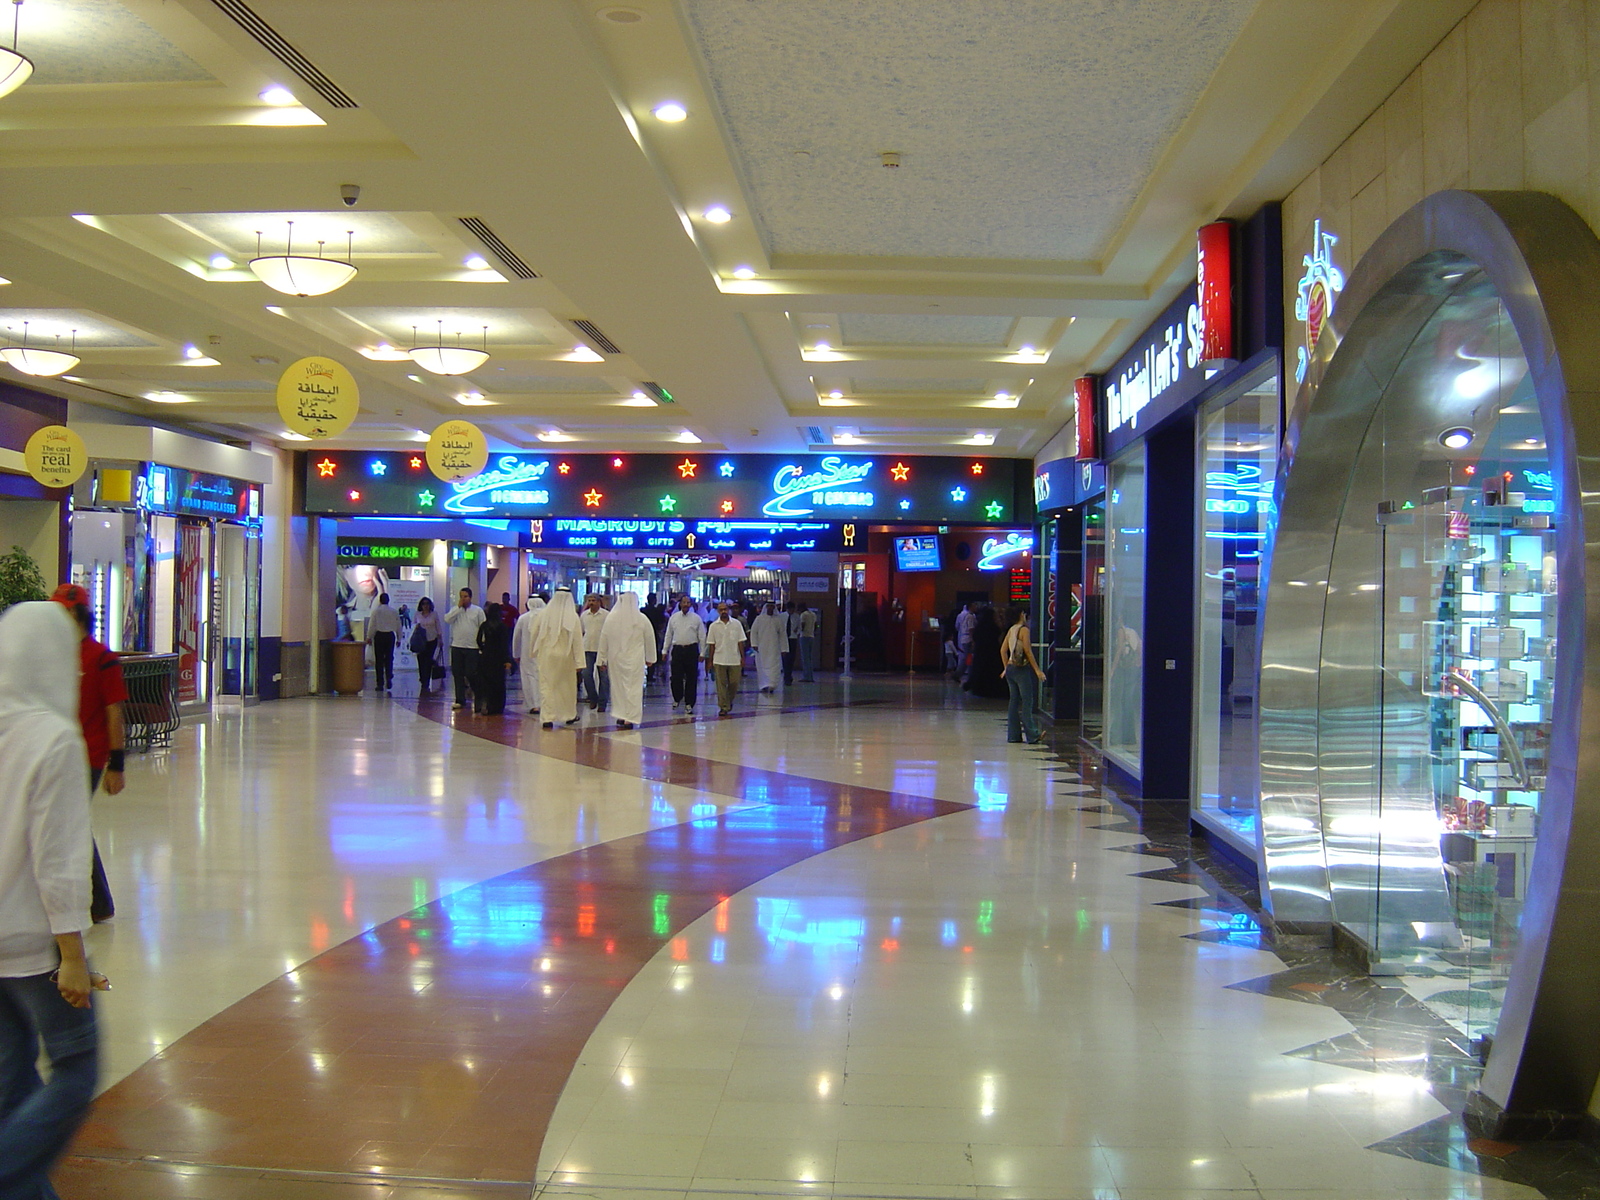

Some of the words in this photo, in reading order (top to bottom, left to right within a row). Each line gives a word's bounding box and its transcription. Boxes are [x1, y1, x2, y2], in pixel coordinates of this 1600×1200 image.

[298, 383, 338, 397] البطاقة
[1107, 383, 1120, 433] The
[1121, 349, 1150, 429] Original
[297, 407, 337, 422] حقيقية
[442, 440, 472, 451] البطاقة
[42, 454, 70, 466] real
[441, 459, 472, 470] حقيقية
[773, 456, 873, 495] CineStar
[202, 499, 237, 514] SUNGLASSES
[568, 536, 597, 545] BOOKS
[611, 536, 634, 546] TOYS
[647, 537, 674, 546] GIFTS
[370, 546, 419, 559] CHOICE
